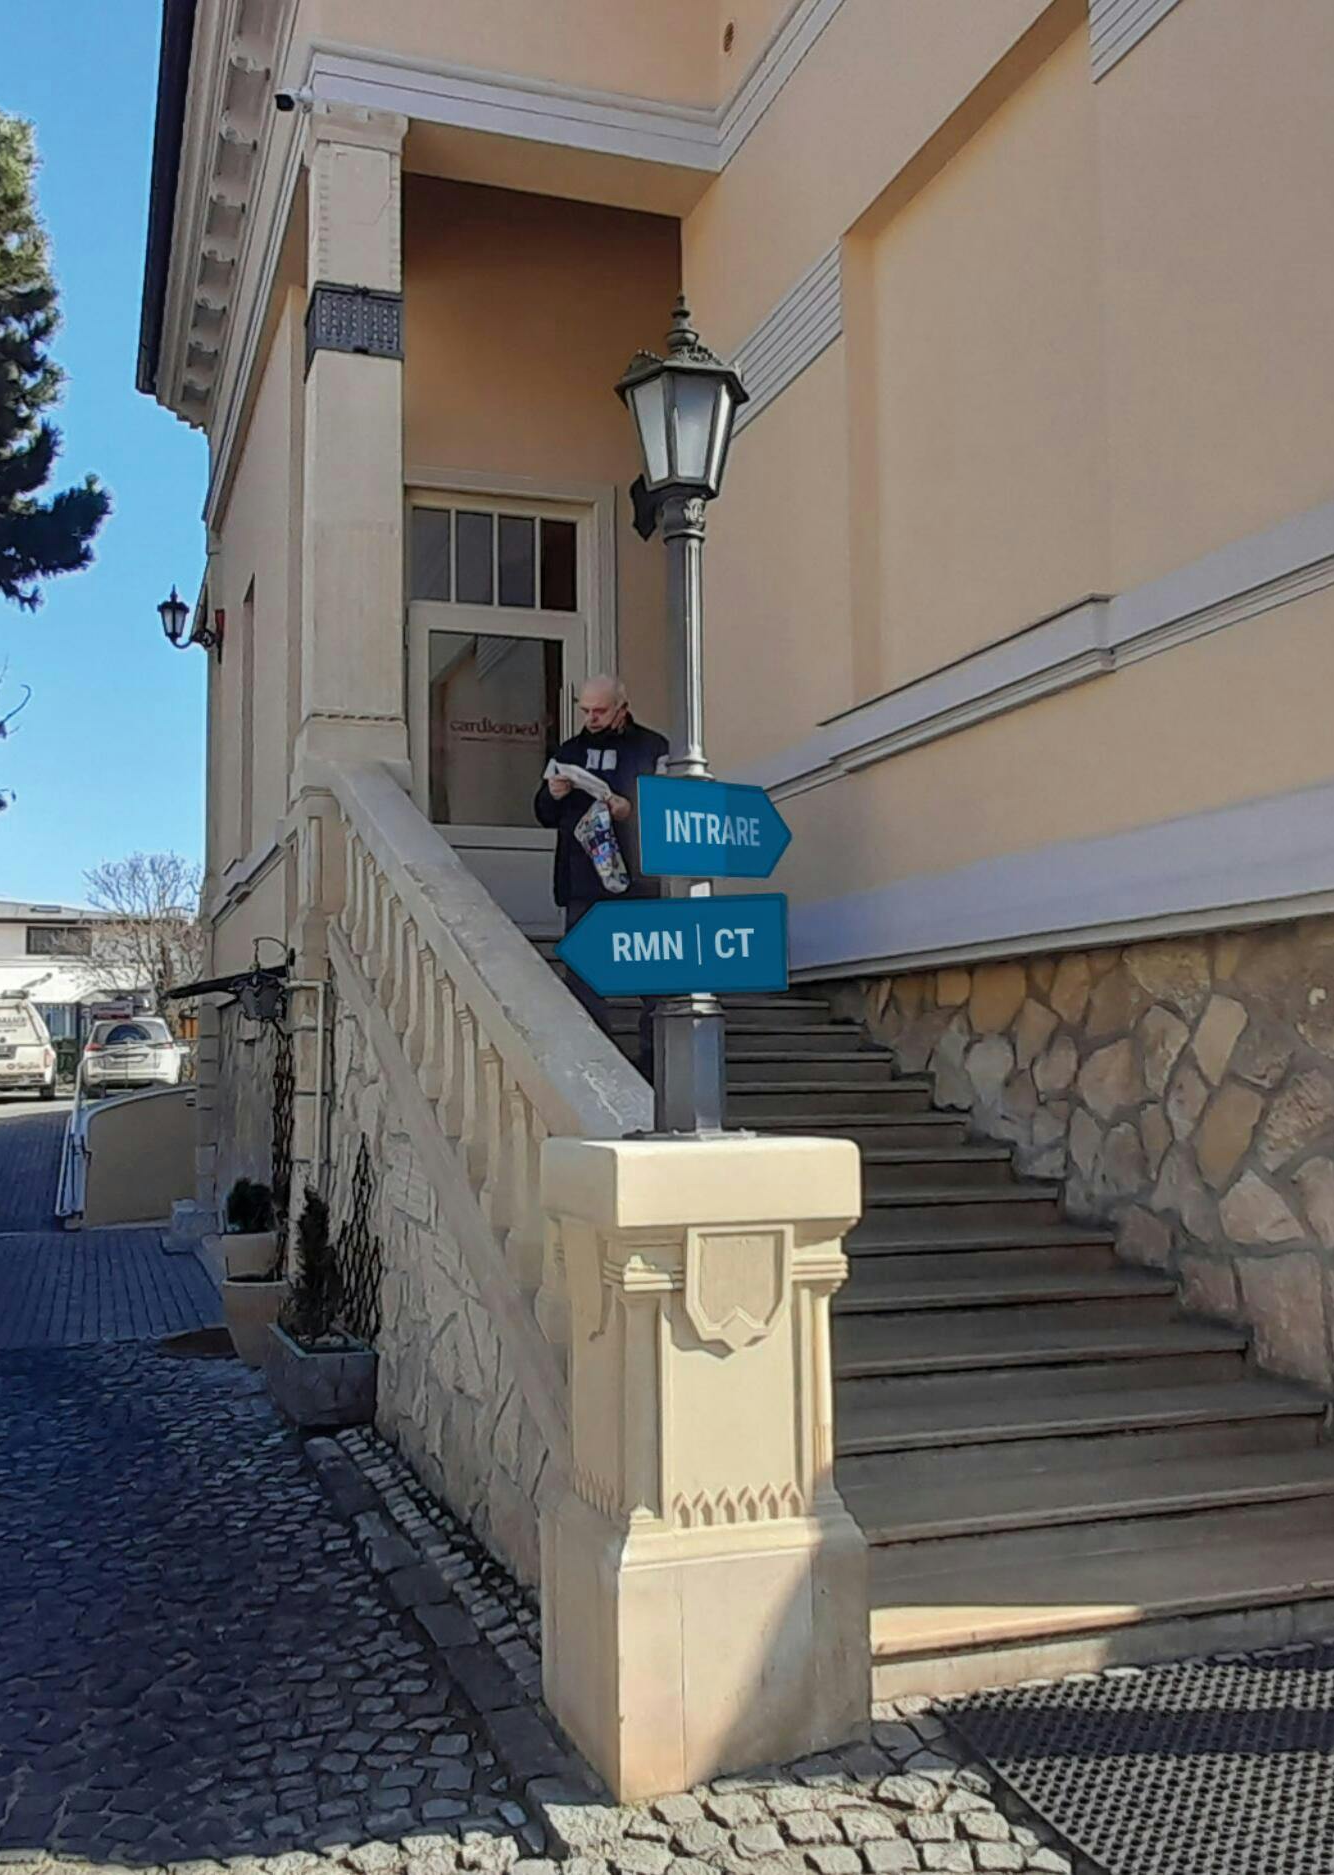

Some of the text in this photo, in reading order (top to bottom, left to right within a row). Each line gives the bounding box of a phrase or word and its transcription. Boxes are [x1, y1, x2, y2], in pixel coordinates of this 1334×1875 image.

[450, 717, 539, 736] cardiomed
[665, 809, 760, 846] INTRARE
[612, 927, 755, 962] RMN CT
